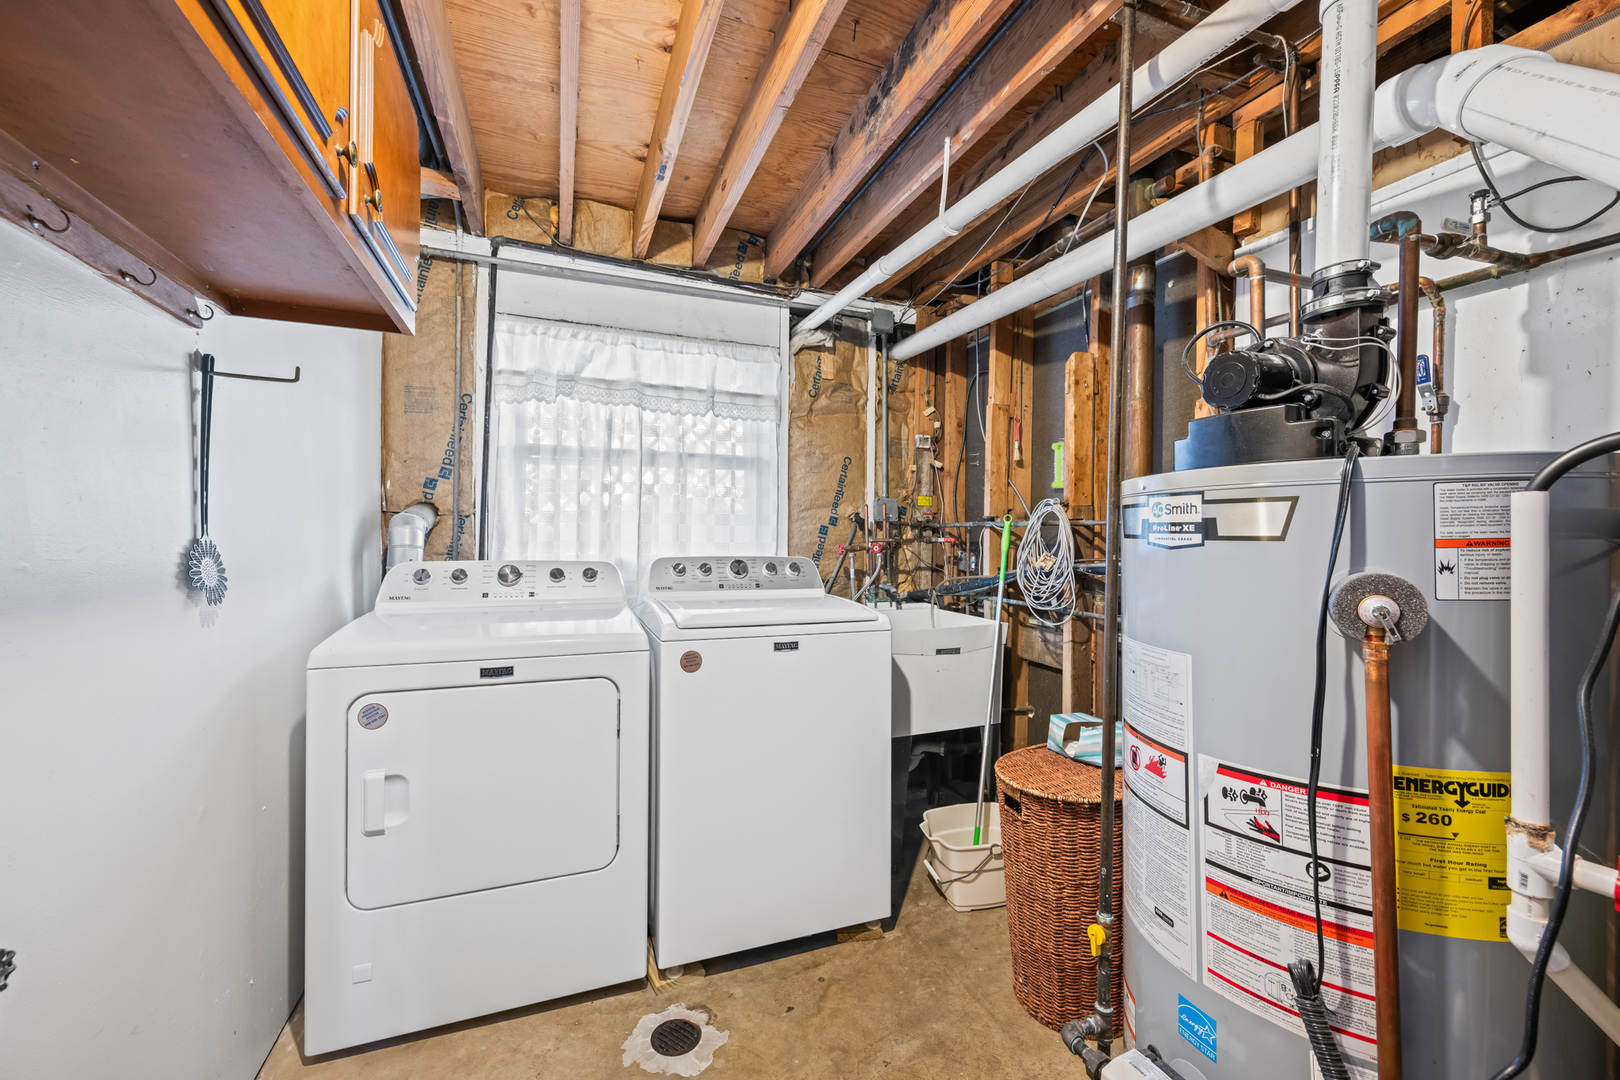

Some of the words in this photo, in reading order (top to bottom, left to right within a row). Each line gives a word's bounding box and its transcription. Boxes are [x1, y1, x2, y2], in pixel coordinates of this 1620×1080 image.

[829, 456, 852, 516] CertainTeed
[1164, 503, 1198, 515] Smith
[481, 667, 513, 676] MAYTAG
[1270, 781, 1307, 796] DANGER
[1394, 776, 1511, 803] ENERGYGUID
[1255, 808, 1271, 817] HOT
[1401, 813, 1411, 823] $
[1415, 812, 1453, 827] 260
[1262, 830, 1281, 841] BURN
[1465, 861, 1488, 869] Rating
[1251, 877, 1328, 906] IMPORTANT/IMPORTATE
[1254, 896, 1278, 910] SAFETY
[1278, 905, 1296, 916] READ
[1324, 920, 1356, 934] LIGHTING
[1178, 1026, 1200, 1048] ENERGY
[1199, 1043, 1216, 1061] STAR
